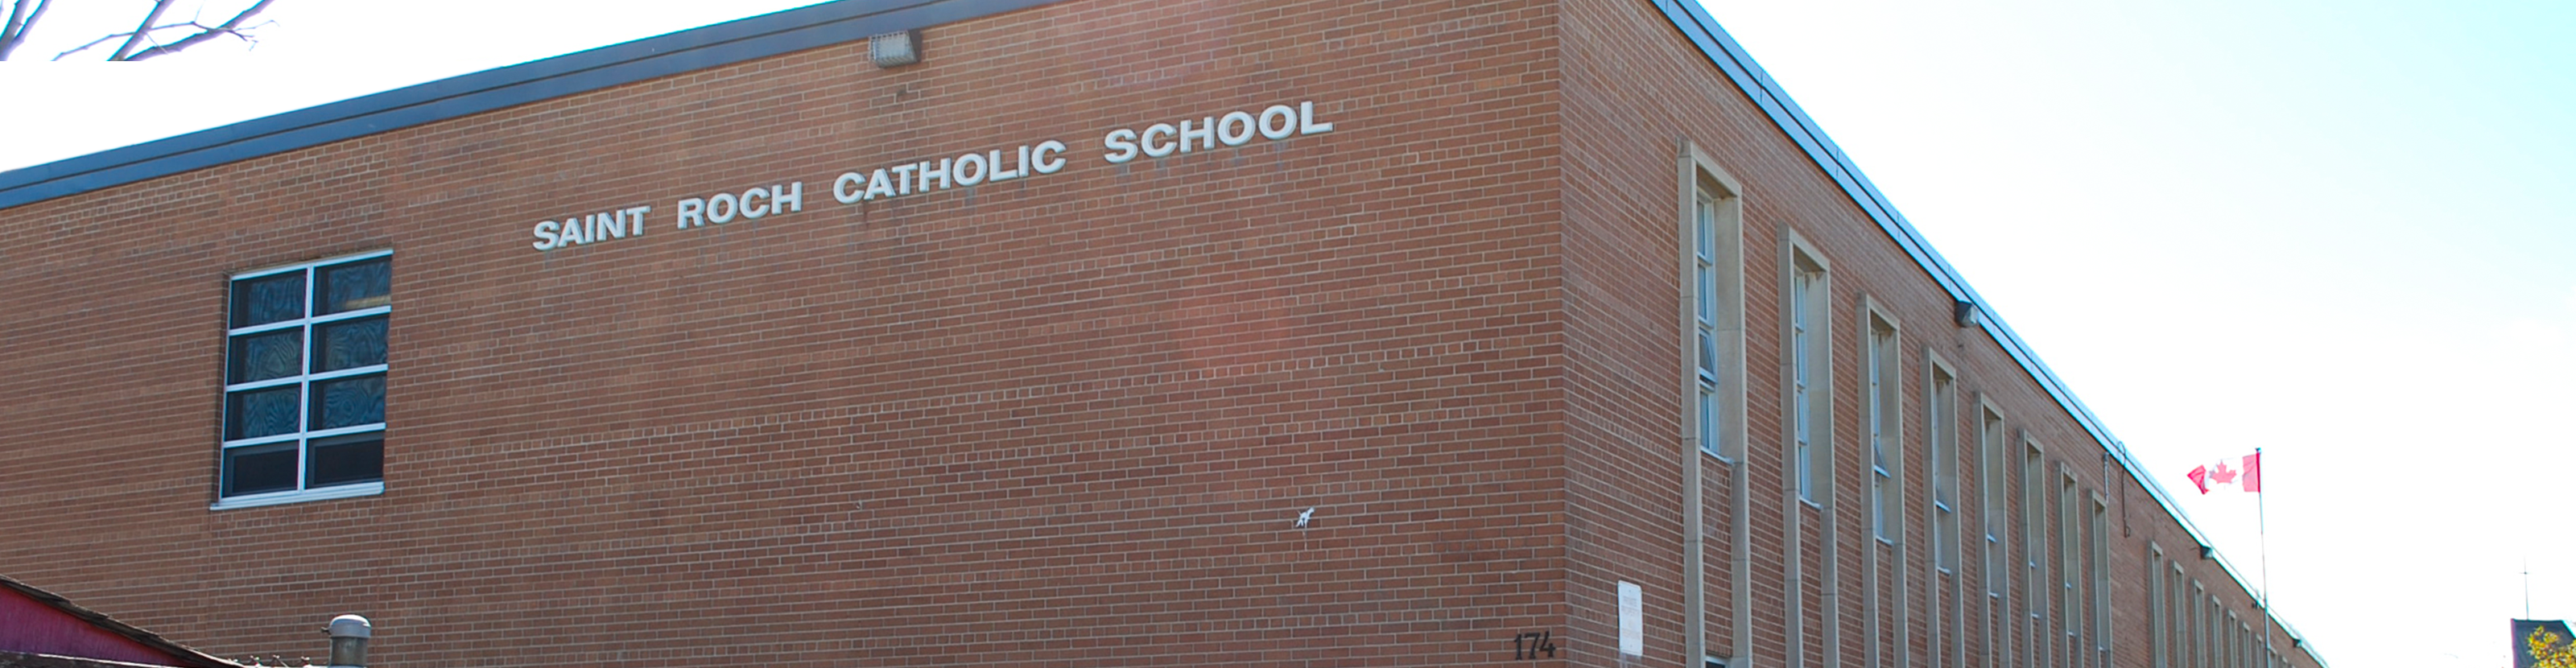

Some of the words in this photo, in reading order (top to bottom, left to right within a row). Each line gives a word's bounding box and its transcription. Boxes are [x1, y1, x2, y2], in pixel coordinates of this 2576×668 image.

[532, 205, 650, 250] SAINT
[676, 181, 803, 230] ROCH
[832, 140, 1067, 204] CATHOLIC
[1104, 101, 1333, 163] SCHOOL
[1513, 630, 1556, 660] 174
